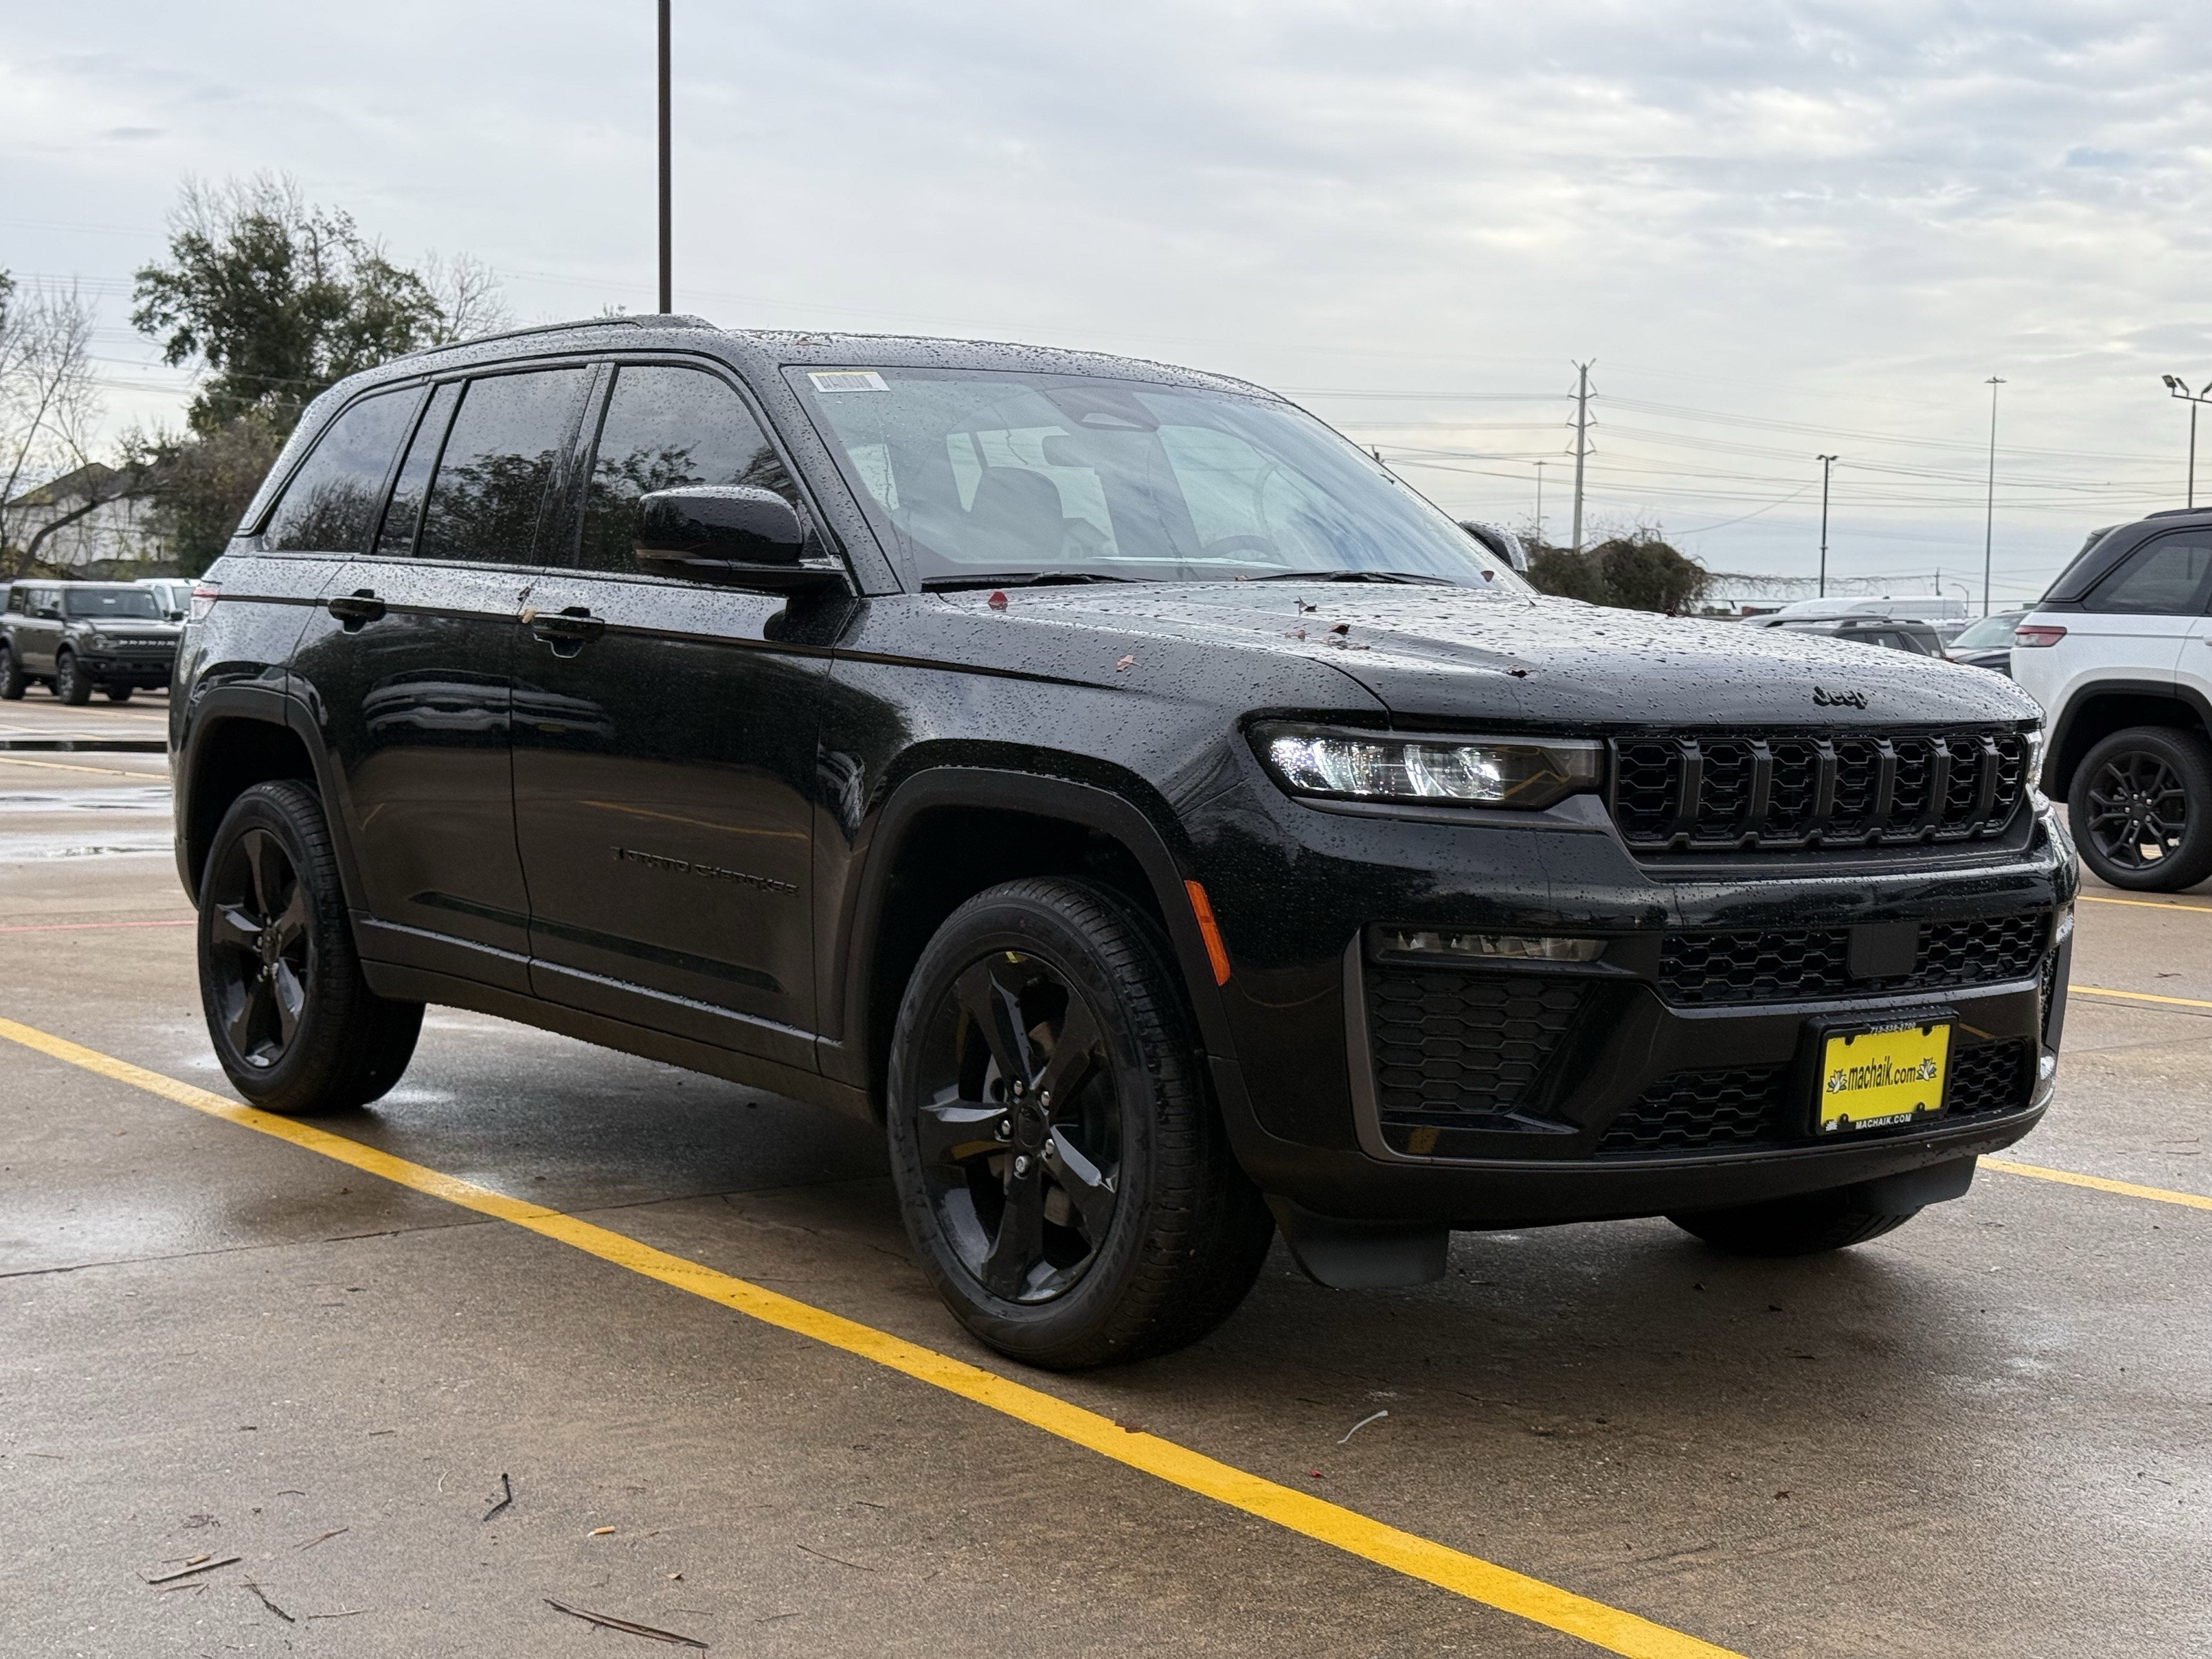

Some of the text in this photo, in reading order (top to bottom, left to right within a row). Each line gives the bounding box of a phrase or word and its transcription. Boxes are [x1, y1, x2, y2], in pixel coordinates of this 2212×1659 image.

[1813, 686, 1868, 710] Jeep
[1847, 1055, 1916, 1091] machaik.com
[1855, 1113, 1912, 1130] MACHAIK.COM
